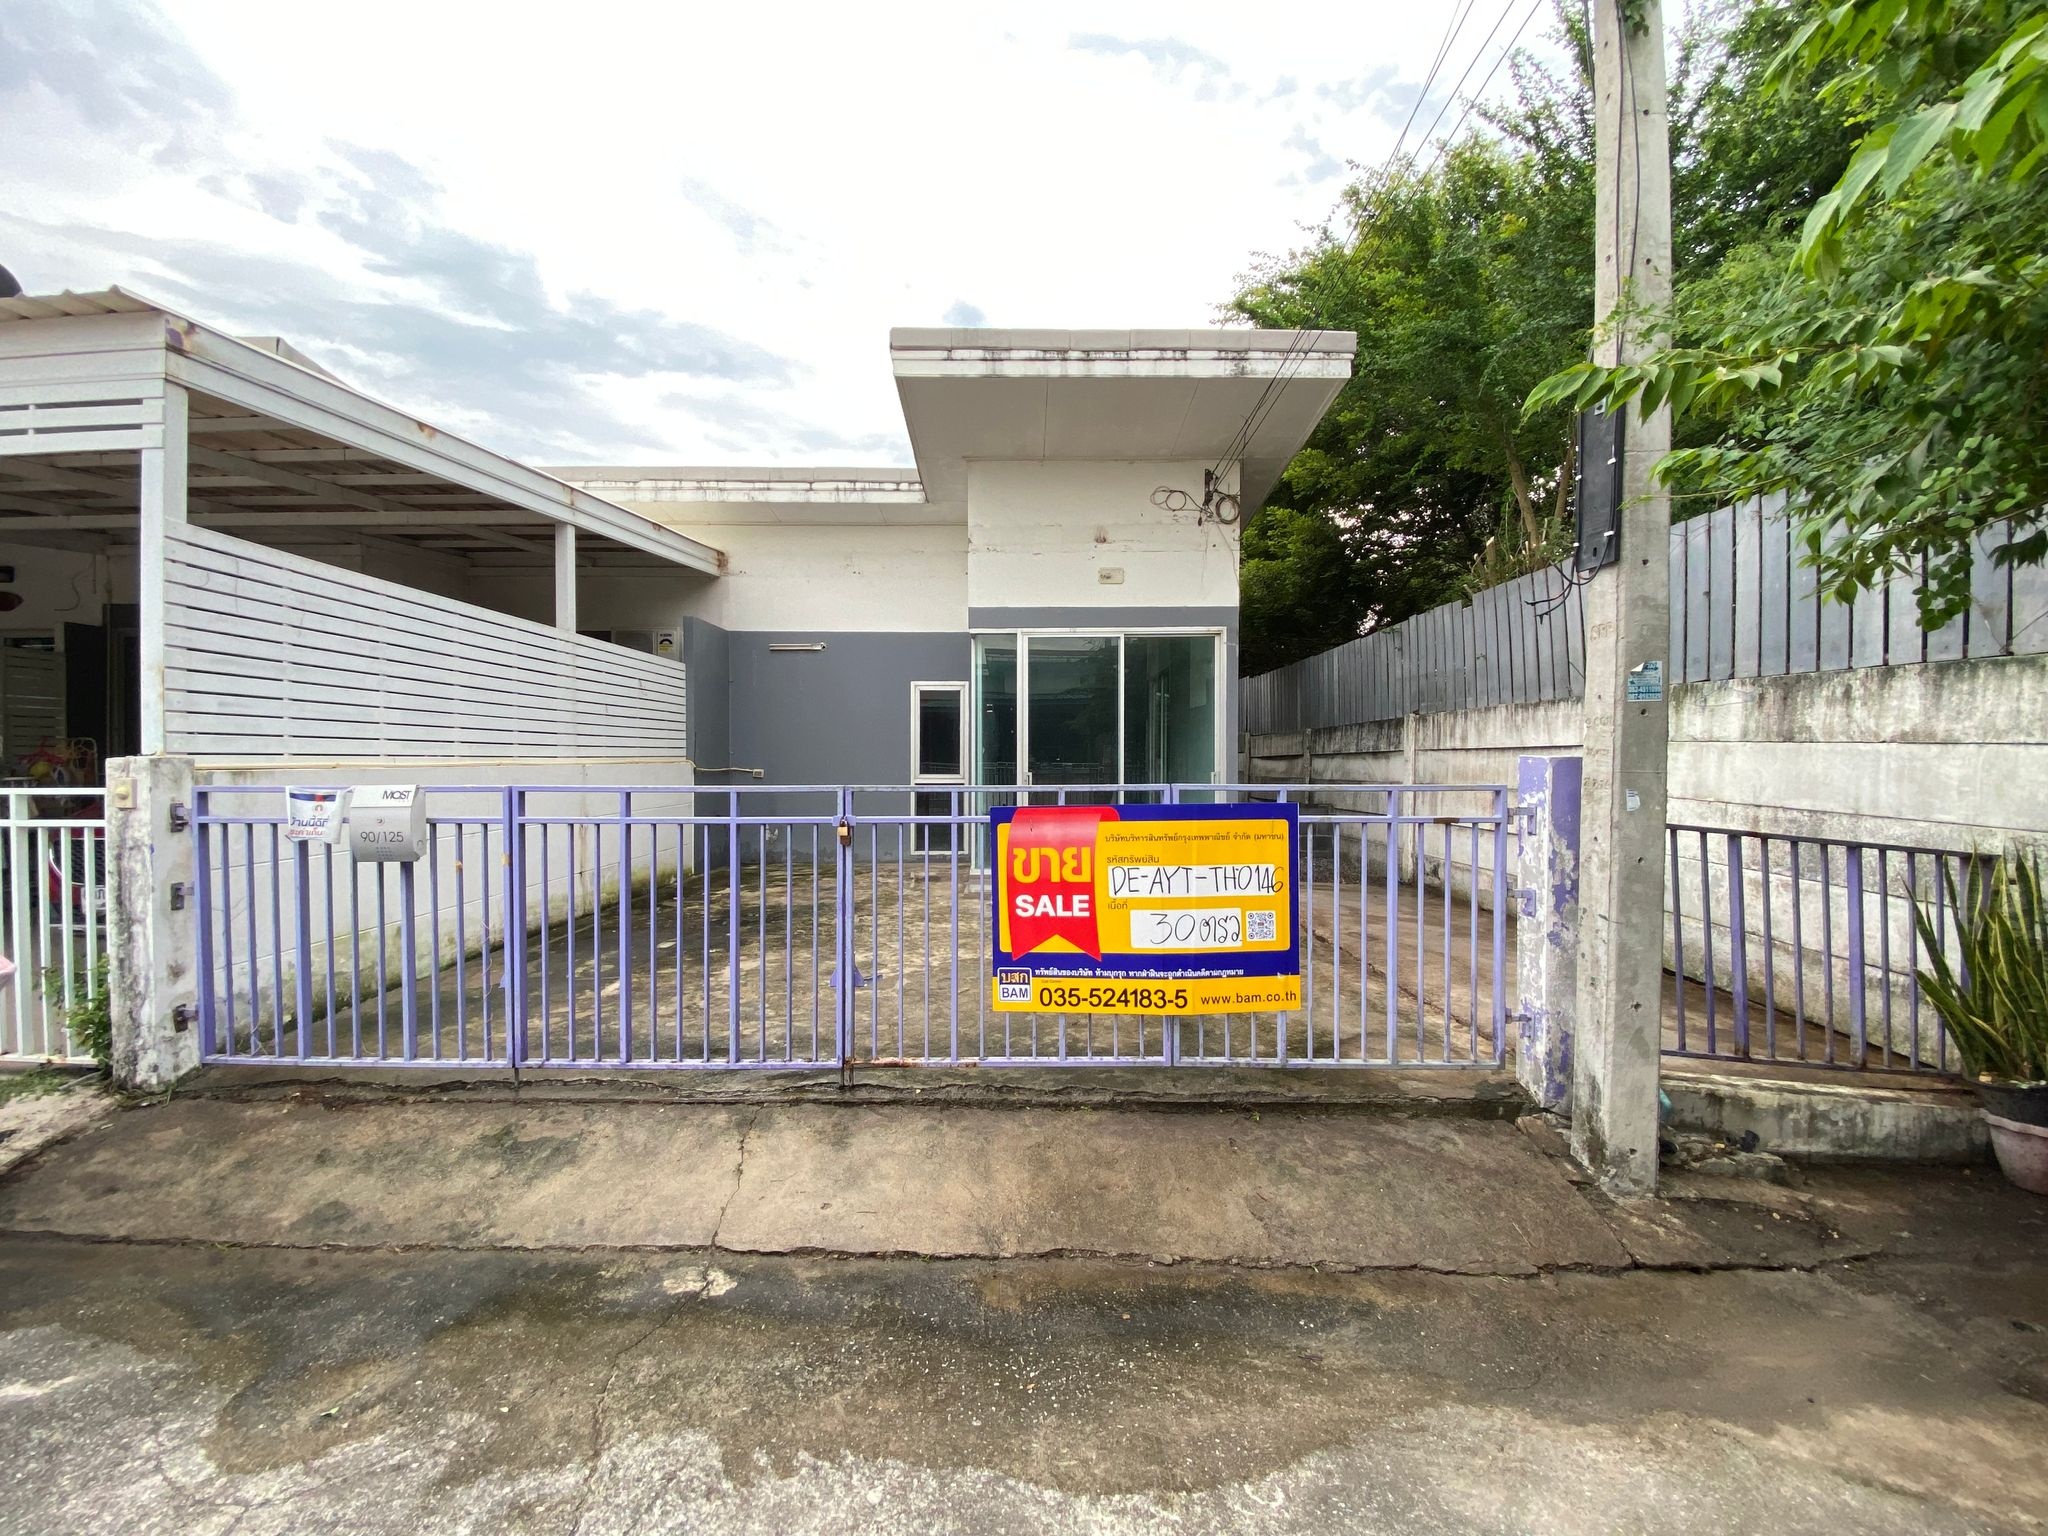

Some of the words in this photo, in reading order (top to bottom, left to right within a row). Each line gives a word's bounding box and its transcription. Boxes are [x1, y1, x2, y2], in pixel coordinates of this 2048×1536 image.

[360, 831, 404, 844] 90/125
[1233, 832, 1251, 841] จำกัด
[1254, 833, 1285, 841] (มหาชน)
[1012, 846, 1092, 883] ขาย
[1106, 854, 1160, 864] รหัสทรัพย์สิน
[1015, 894, 1090, 917] SALE
[1107, 898, 1128, 910] เนื้อที่
[1001, 971, 1028, 983] บสก
[1001, 987, 1028, 998] BAM
[1039, 987, 1188, 1008] 035-524183-5
[1201, 991, 1297, 1004] www.bam.co.th
